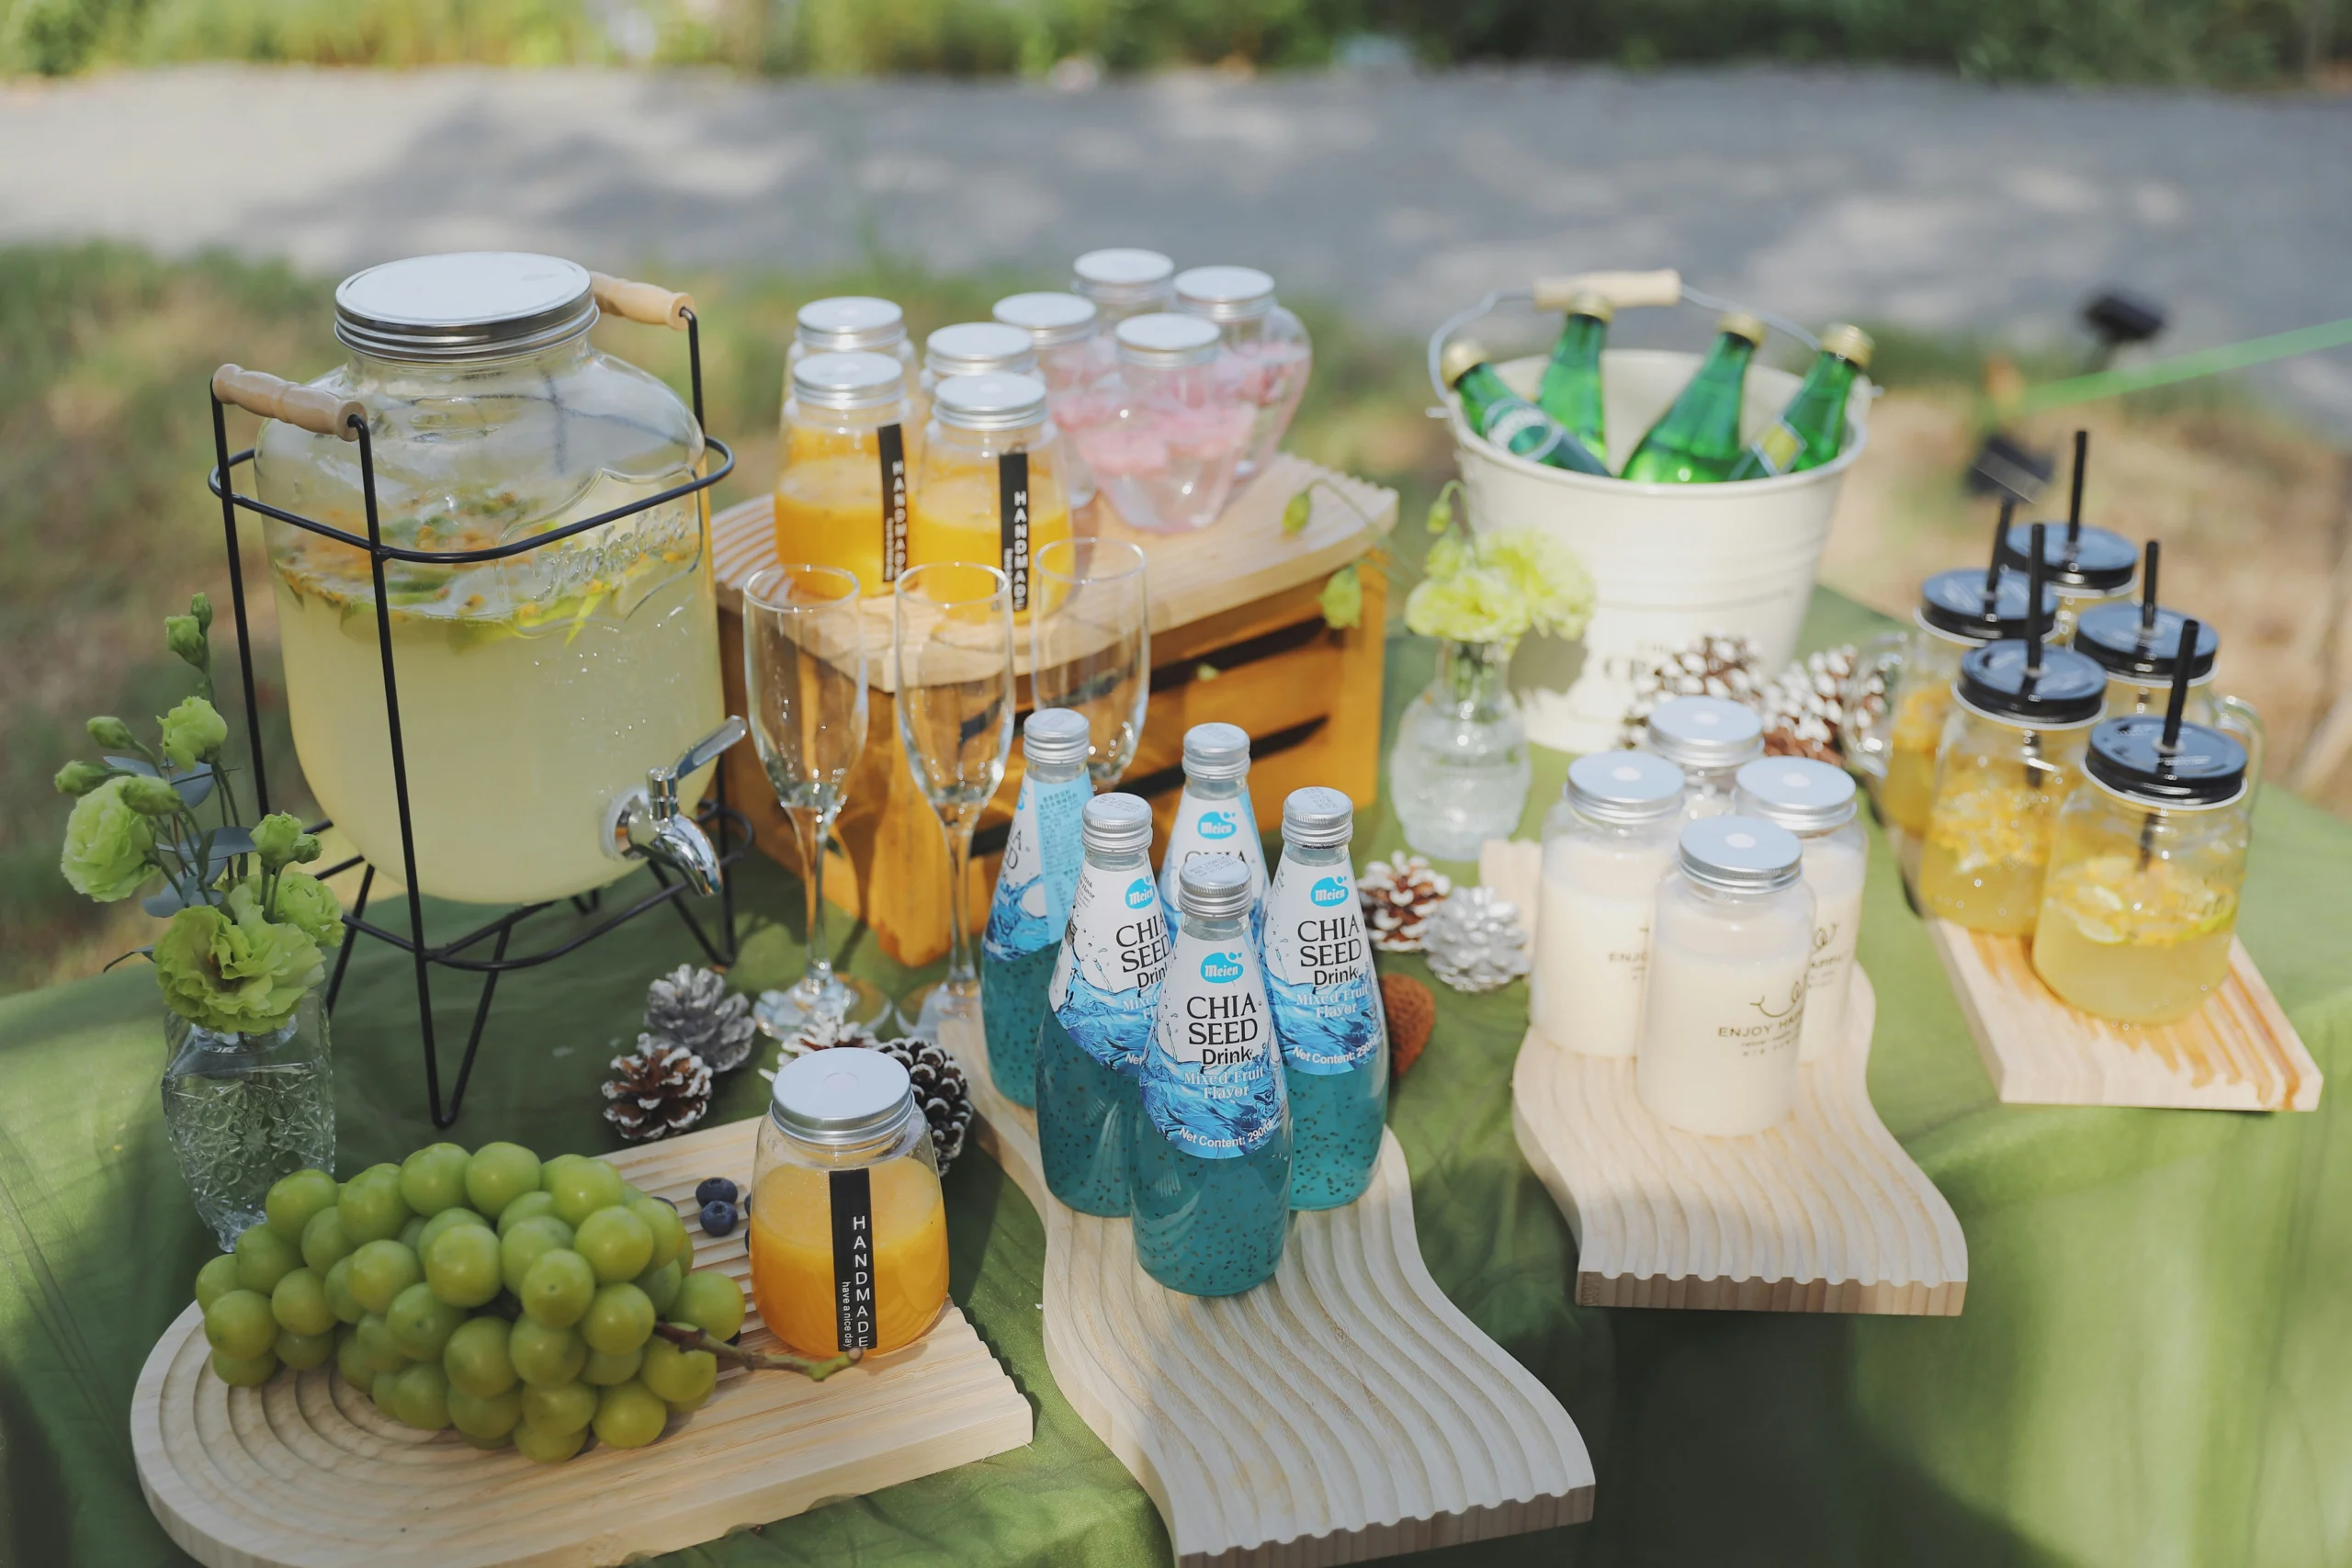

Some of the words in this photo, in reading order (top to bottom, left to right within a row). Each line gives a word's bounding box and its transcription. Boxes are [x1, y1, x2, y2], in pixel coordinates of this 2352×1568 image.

[1013, 491, 1028, 612] HANDMADE
[1315, 888, 1346, 902] Meien
[1297, 914, 1360, 942] CHIA
[1121, 934, 1170, 973] SEED
[1300, 938, 1362, 967] SEED
[1204, 964, 1238, 977] Meien
[1314, 965, 1359, 986] Drink
[1296, 989, 1339, 1006] Mixed
[1343, 983, 1369, 1000] Fruit
[1186, 992, 1257, 1020] CHIA
[1316, 1002, 1358, 1019] Flavor
[1189, 1018, 1258, 1045] SEED
[1718, 1023, 1773, 1037] ENJOY
[1202, 1046, 1253, 1066] Drink
[1293, 1045, 1312, 1062] Net
[1312, 1050, 1355, 1065] Content:
[1183, 1071, 1229, 1086] Mixed
[1234, 1066, 1264, 1082] Fruit
[1204, 1085, 1250, 1100] Flavor
[1179, 1126, 1197, 1143] Net
[1198, 1135, 1246, 1147] Content:
[842, 1281, 851, 1303] have
[853, 1215, 870, 1348] HANDMADE
[843, 1313, 854, 1332] nice
[842, 1333, 854, 1348] day
